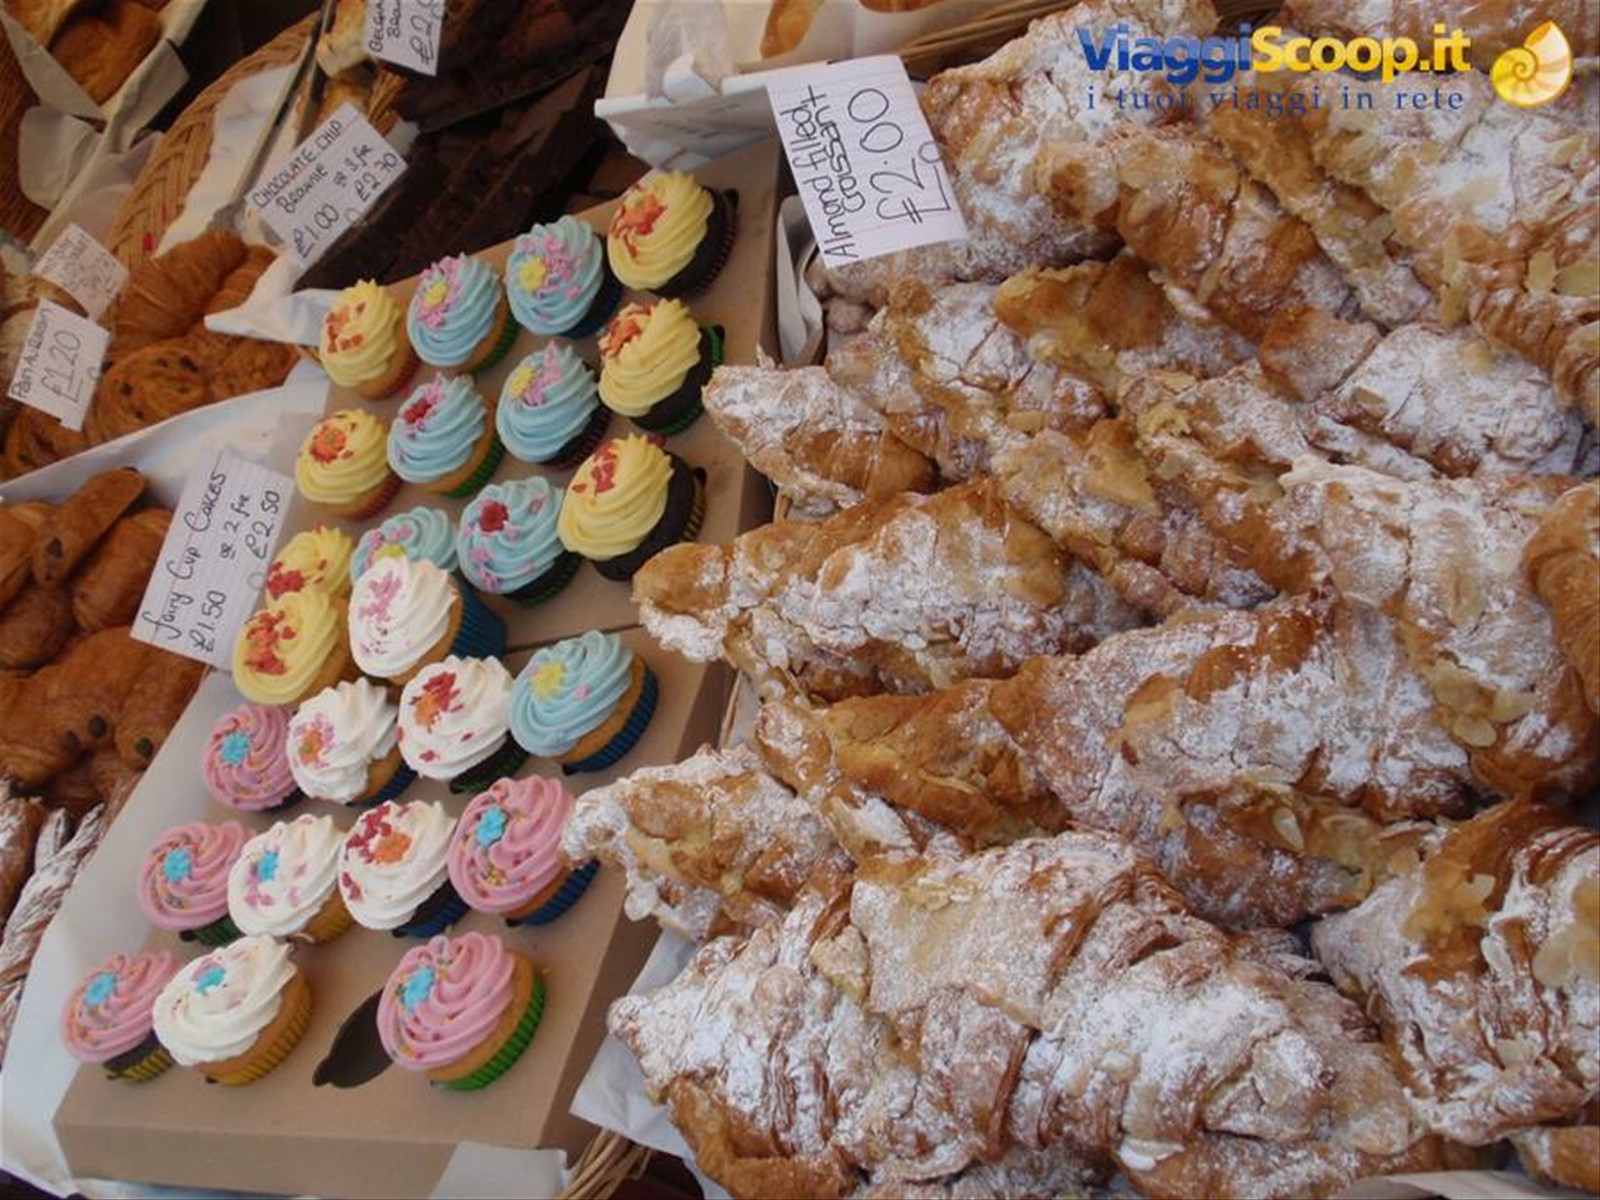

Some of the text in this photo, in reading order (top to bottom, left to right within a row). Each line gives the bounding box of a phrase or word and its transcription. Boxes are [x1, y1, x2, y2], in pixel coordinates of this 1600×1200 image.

[251, 119, 343, 209] CHOCOLATE CHIP
[780, 103, 859, 259] Almond filled
[847, 87, 951, 224] £2.00
[224, 518, 241, 533] 2
